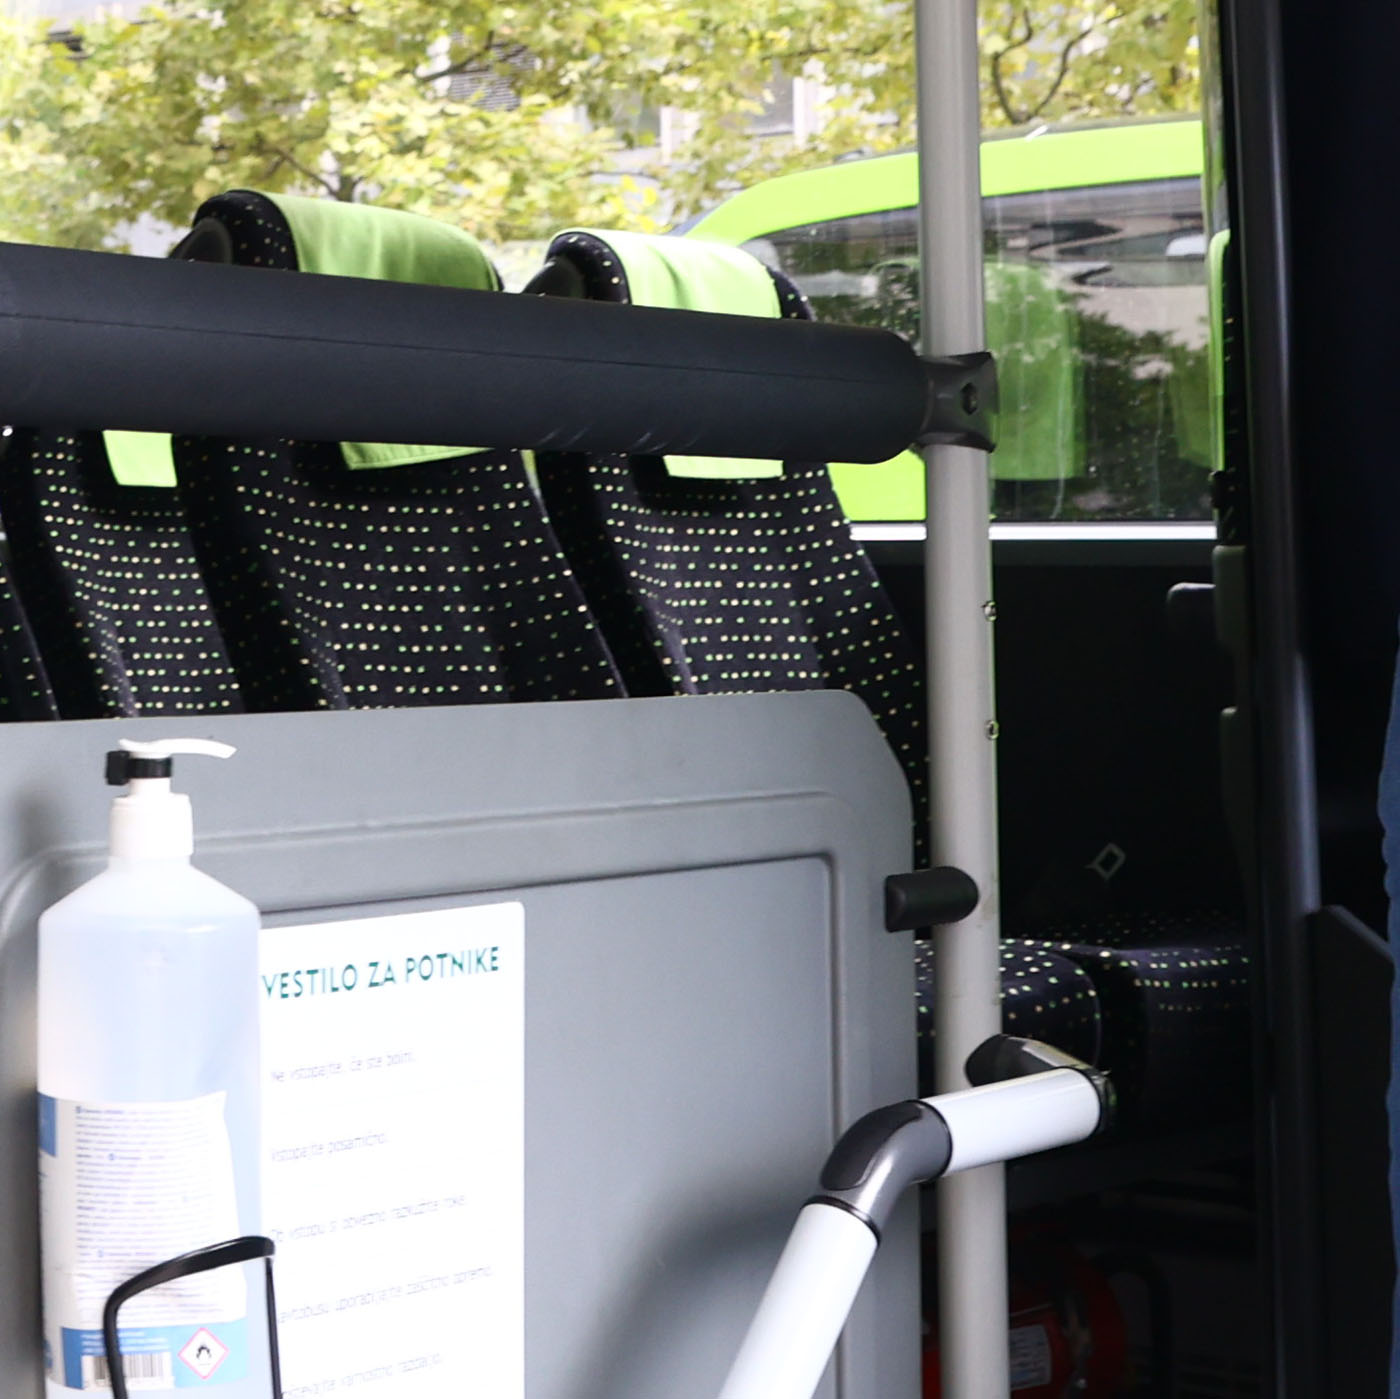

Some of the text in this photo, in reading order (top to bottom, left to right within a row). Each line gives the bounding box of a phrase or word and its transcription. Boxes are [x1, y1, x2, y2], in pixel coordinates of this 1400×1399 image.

[261, 946, 499, 999] VESTILO ZA POTNIKE
